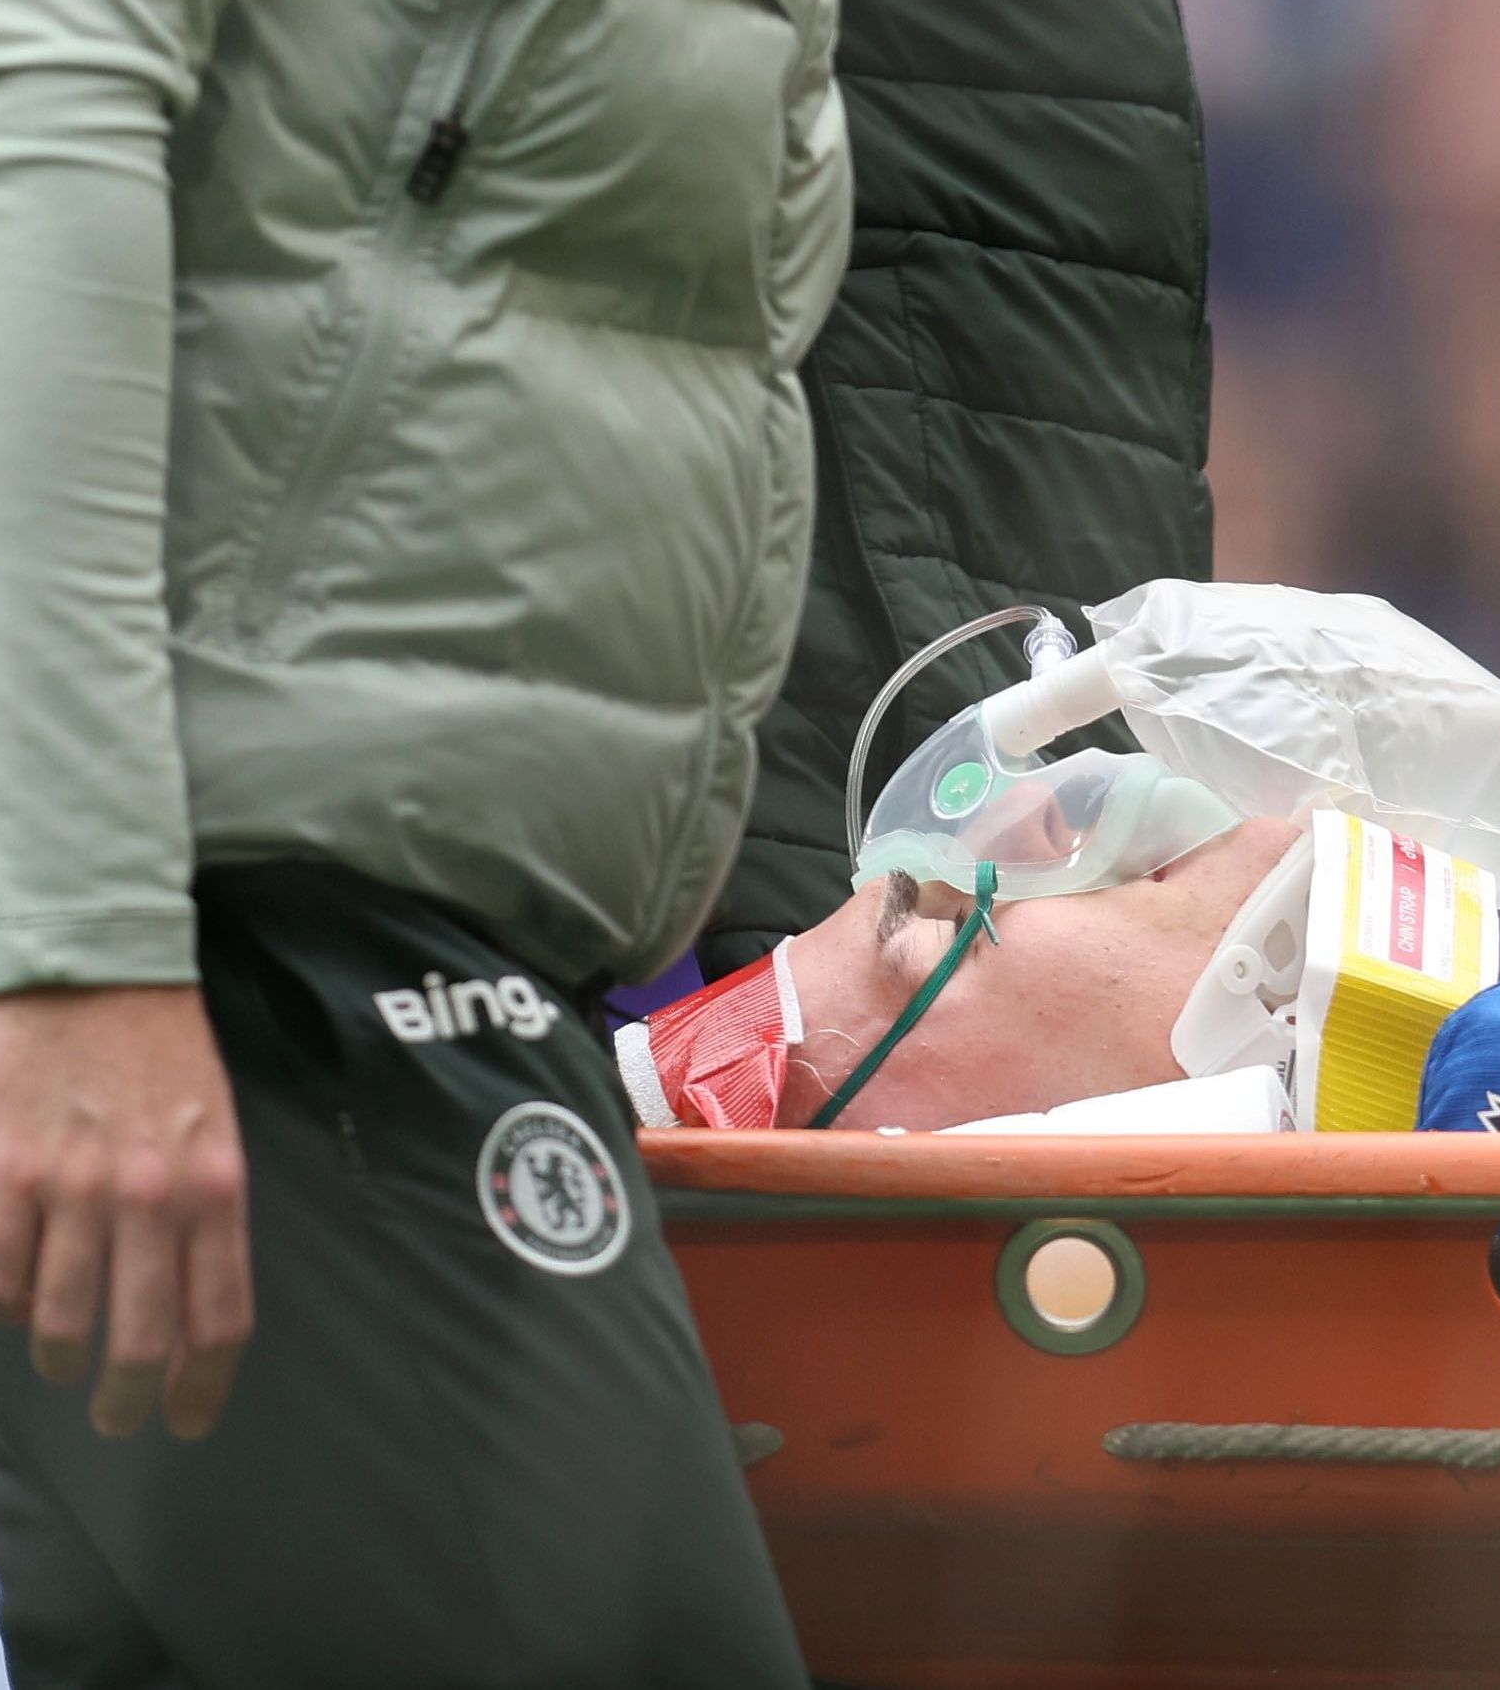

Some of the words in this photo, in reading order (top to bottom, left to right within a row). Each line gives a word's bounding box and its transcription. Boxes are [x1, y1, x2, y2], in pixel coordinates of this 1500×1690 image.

[1398, 886, 1417, 924] STRAP
[1397, 922, 1416, 953] CHIN
[373, 971, 560, 1042] Bing
